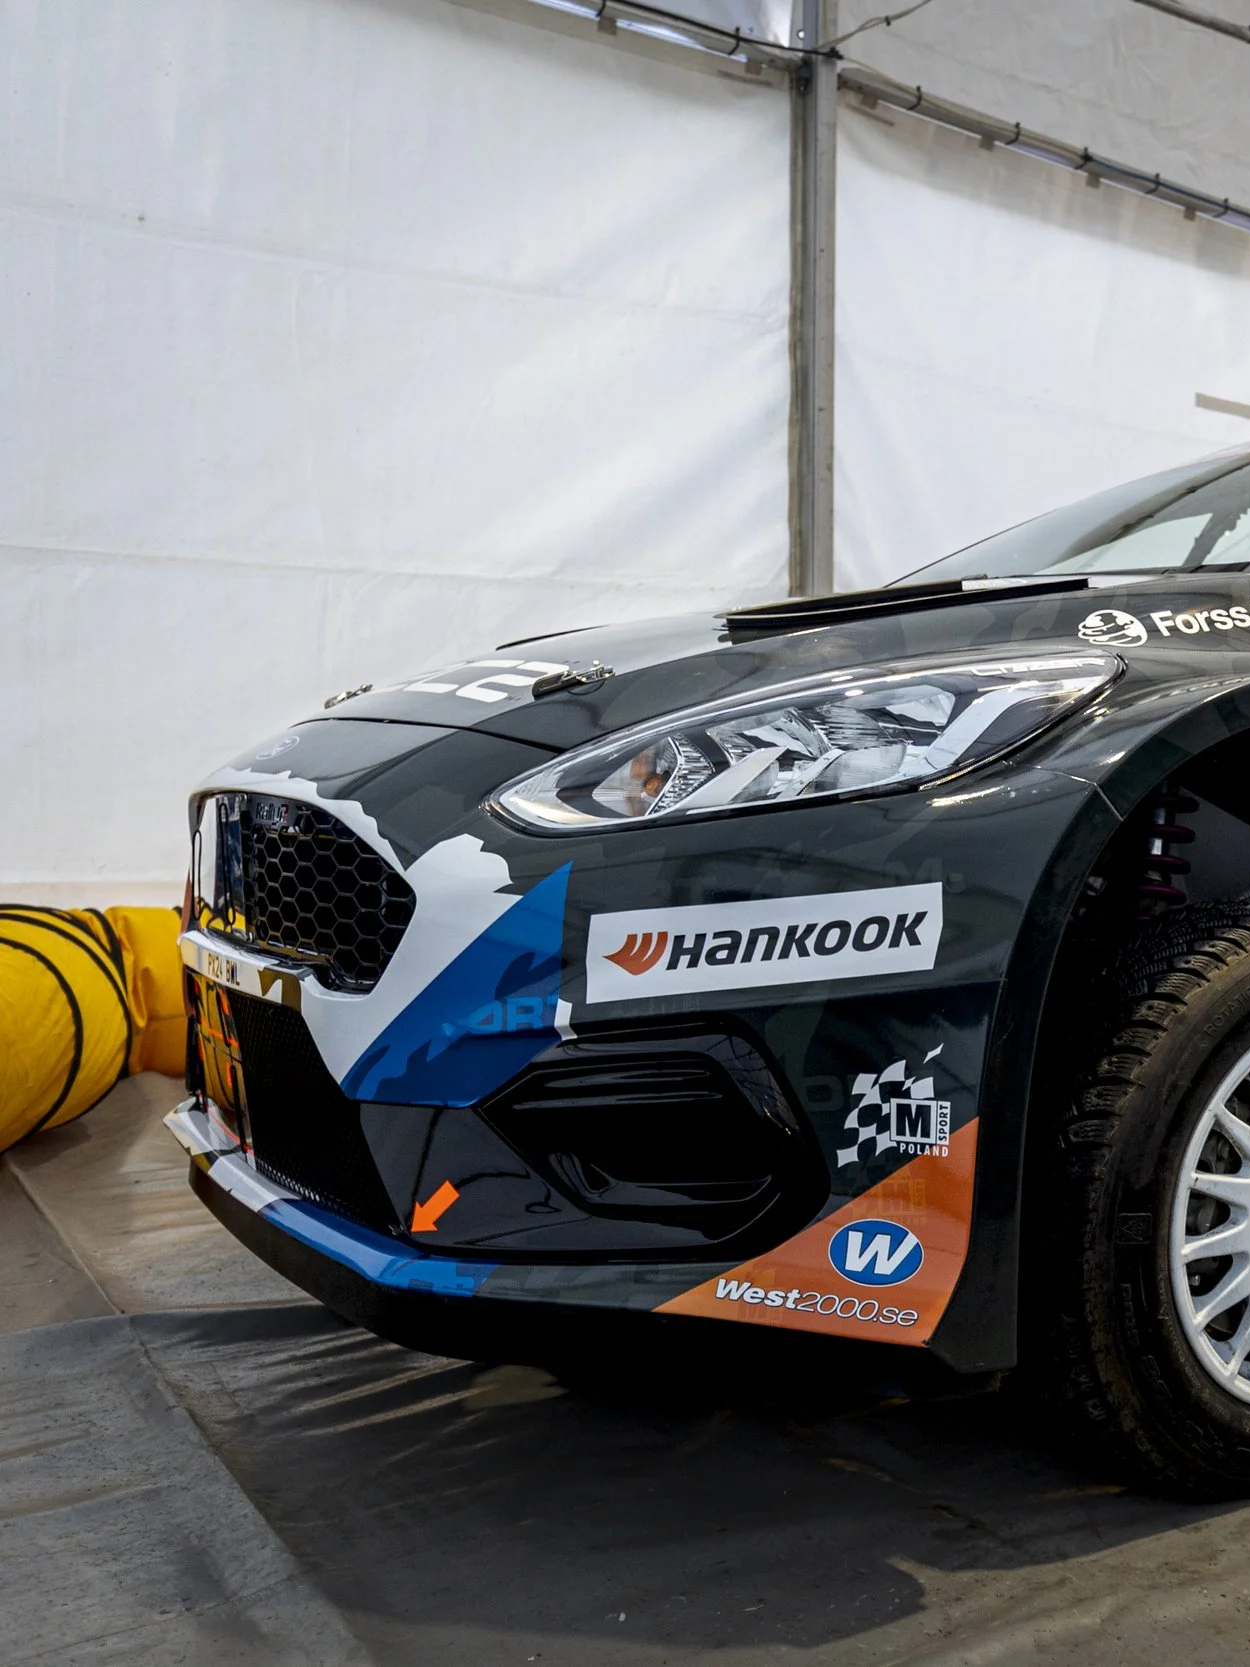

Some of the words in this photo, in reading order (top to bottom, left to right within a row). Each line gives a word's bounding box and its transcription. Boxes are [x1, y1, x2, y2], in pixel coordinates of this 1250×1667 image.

[896, 1103, 932, 1139] M
[938, 1104, 949, 1142] SPORT
[900, 1142, 949, 1157] POLAND
[844, 1230, 919, 1276] W
[714, 1278, 919, 1327] West2000.se
